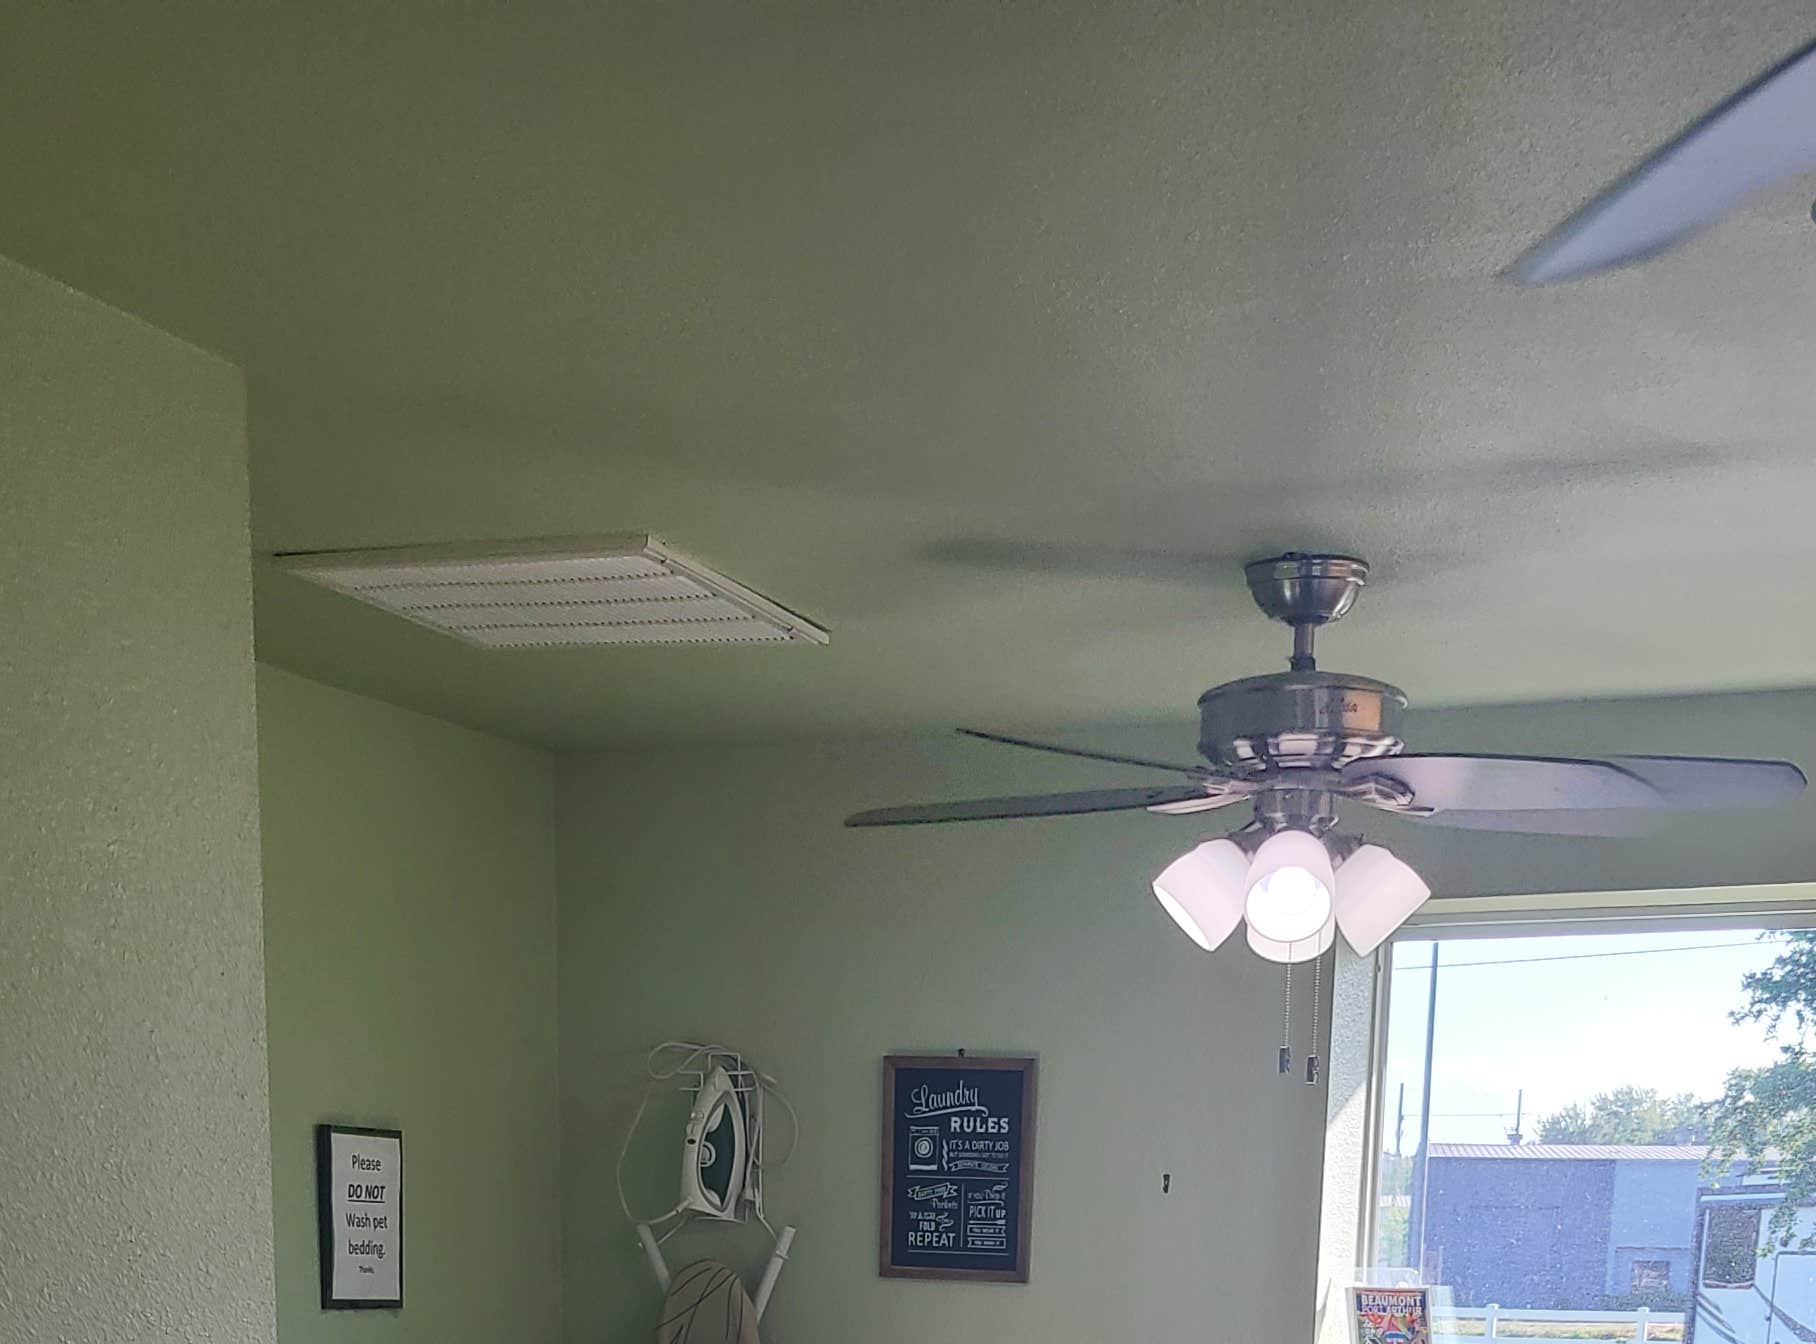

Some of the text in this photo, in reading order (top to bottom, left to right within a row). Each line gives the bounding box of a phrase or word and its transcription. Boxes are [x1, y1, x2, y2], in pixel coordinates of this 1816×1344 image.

[908, 1080, 983, 1115] Laundry
[950, 1116, 1009, 1133] RULES
[964, 1141, 971, 1150] A
[971, 1141, 993, 1151] DIRTY
[994, 1141, 1009, 1151] JOB
[351, 1154, 381, 1172] Please
[347, 1183, 386, 1201] DO NOT
[969, 1205, 1006, 1218] PICK IT UP
[345, 1212, 388, 1233] Wash pet
[919, 1221, 936, 1231] FOLD
[908, 1231, 956, 1248] REPEAT
[348, 1240, 386, 1259] bedding.
[1360, 1295, 1422, 1307] BEAUMONT
[1386, 1306, 1422, 1316] ARTHUR
